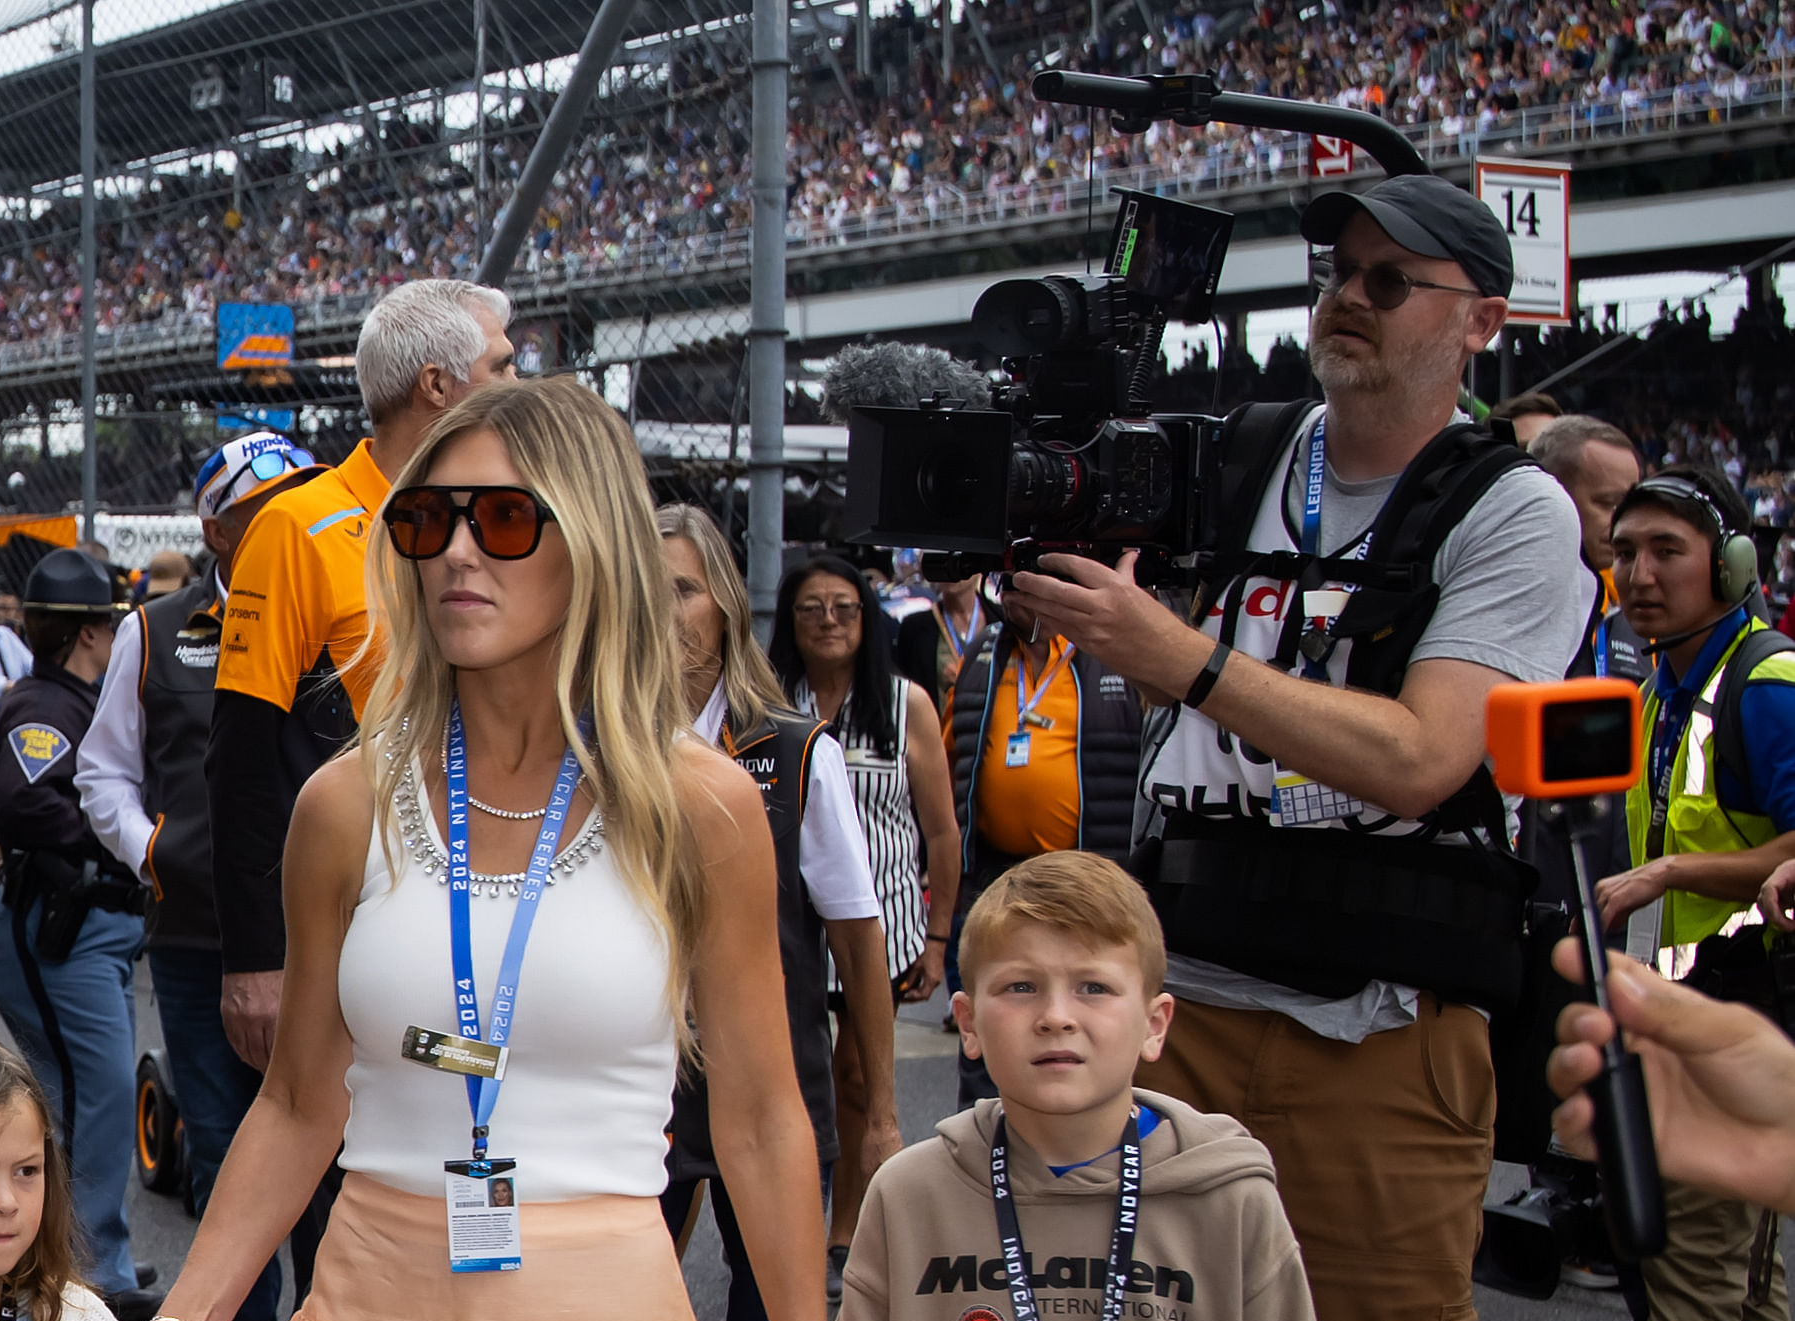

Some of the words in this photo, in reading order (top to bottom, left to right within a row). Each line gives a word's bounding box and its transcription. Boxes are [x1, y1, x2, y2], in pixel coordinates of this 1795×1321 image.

[1502, 187, 1541, 237] 14
[1307, 440, 1324, 515] LEGENDS
[450, 705, 466, 778] INDYCA
[451, 788, 466, 825] NTT
[547, 750, 579, 821] DYCAR
[452, 839, 468, 891] 2024
[523, 830, 556, 902] SERIES
[457, 977, 479, 1037] 2024
[491, 985, 514, 1043] 2024
[991, 1146, 1008, 1200] 2024
[1119, 1143, 1140, 1234] INDYCAR
